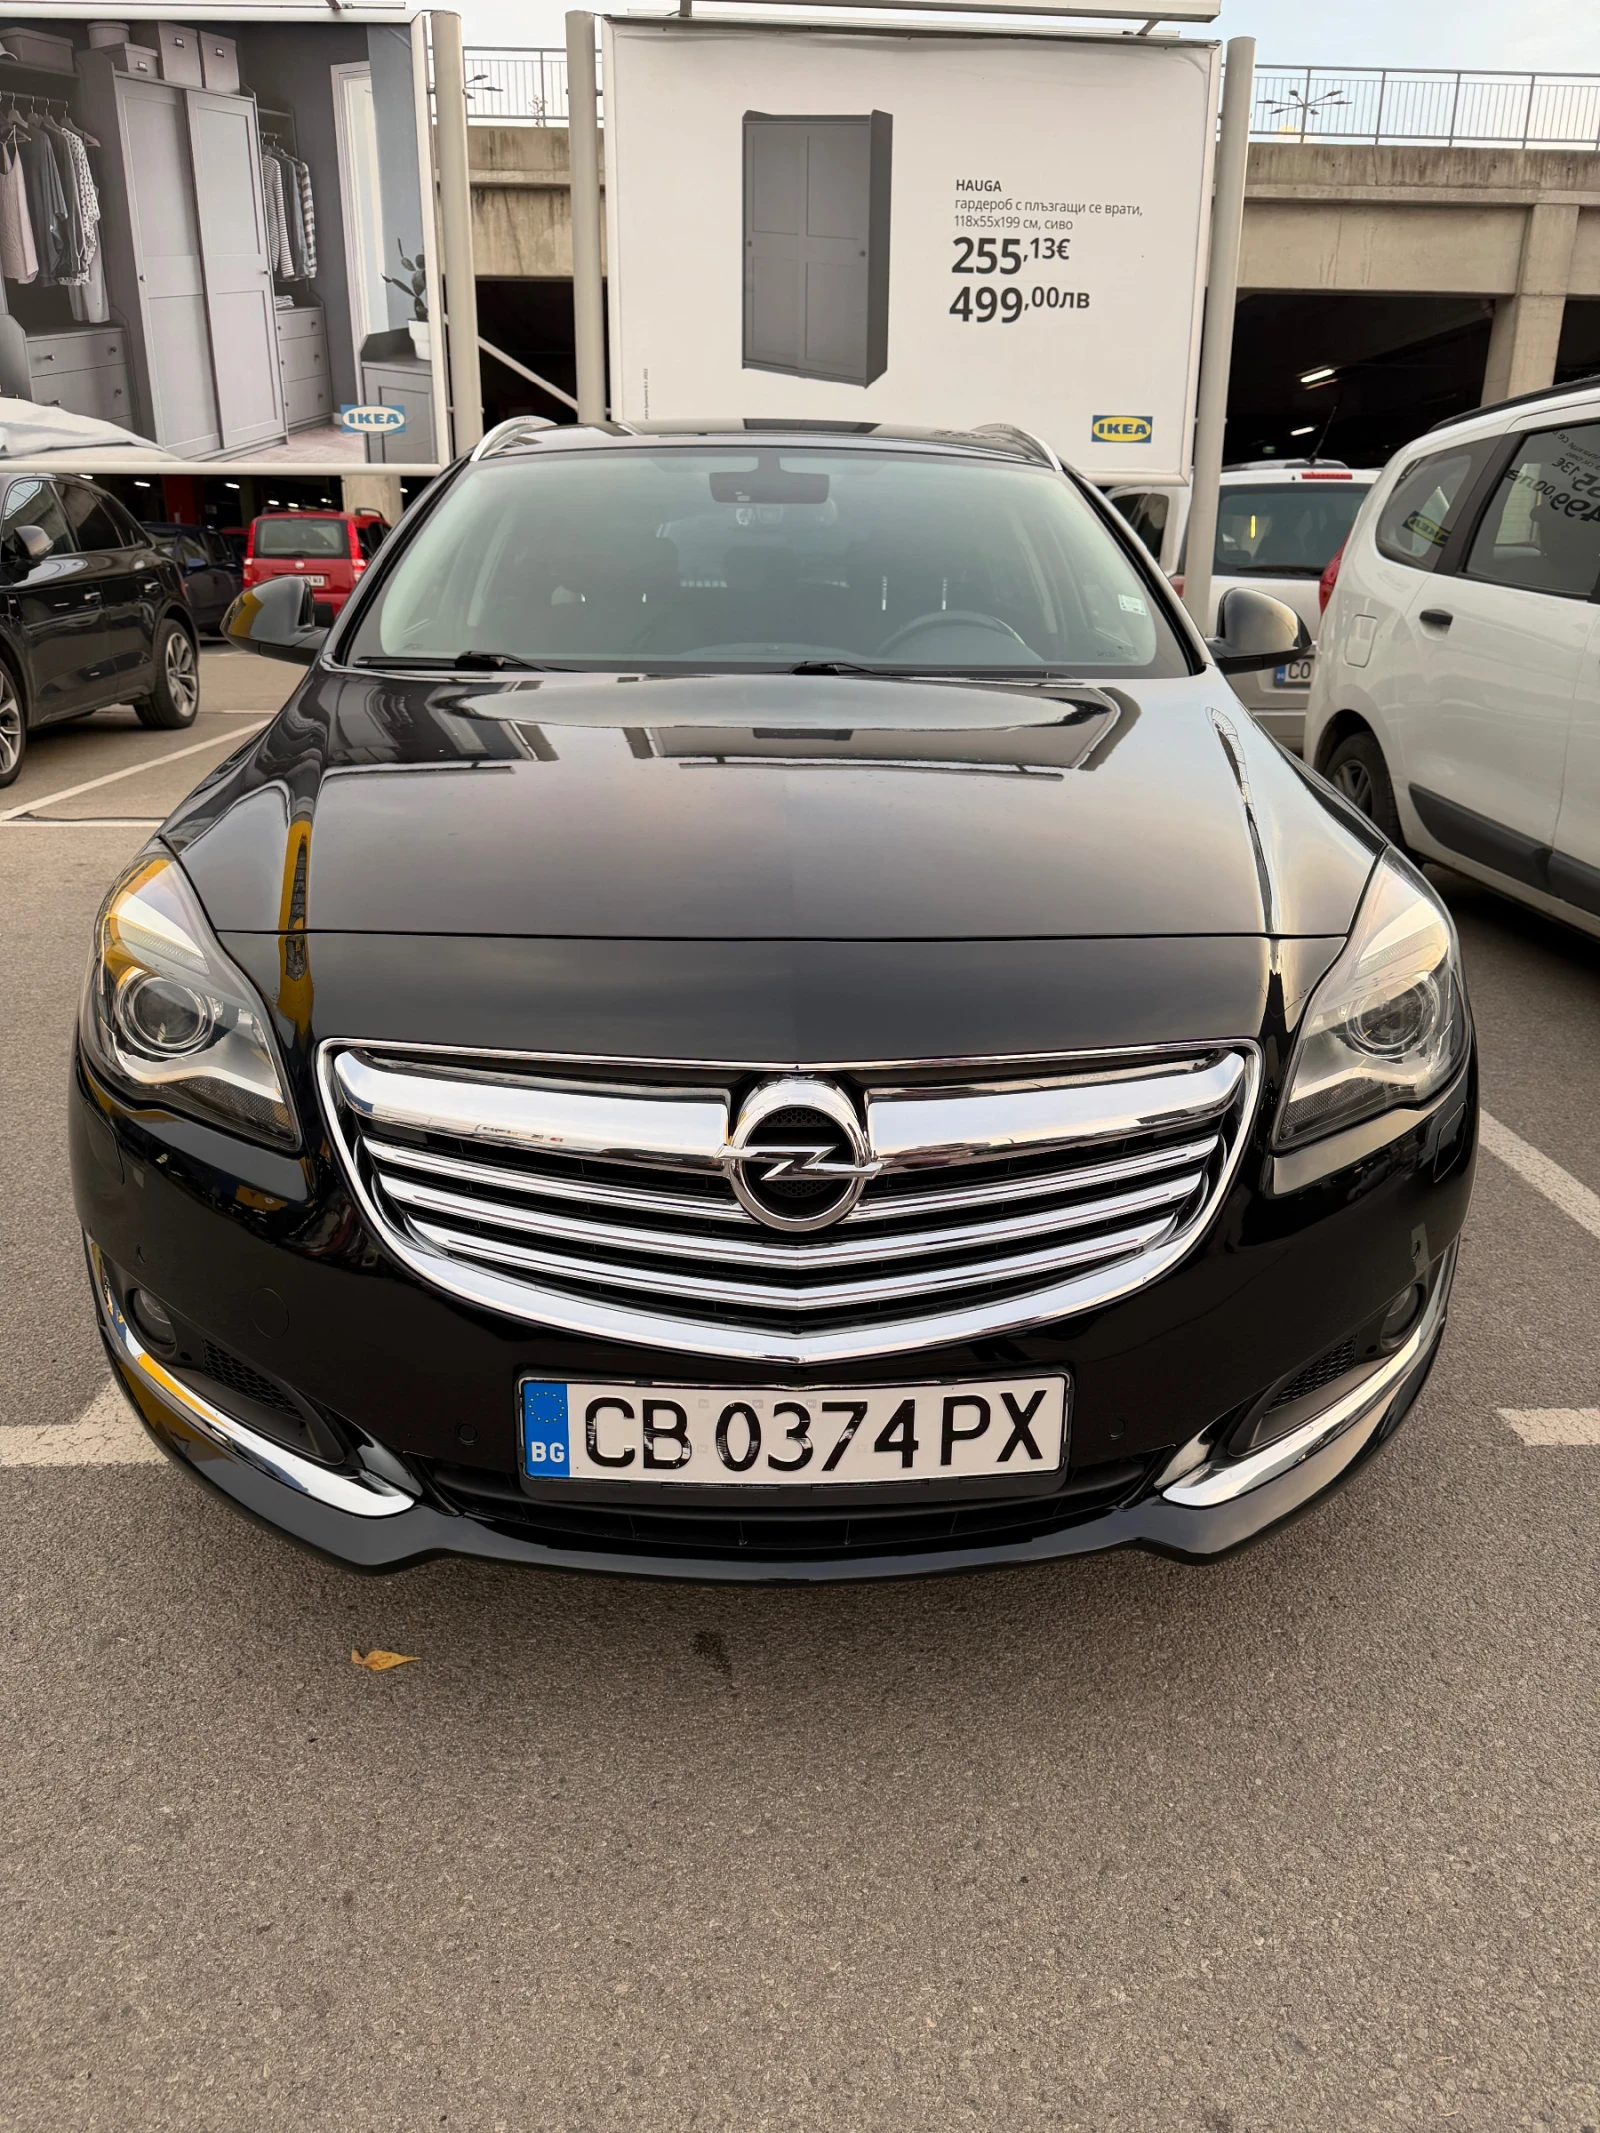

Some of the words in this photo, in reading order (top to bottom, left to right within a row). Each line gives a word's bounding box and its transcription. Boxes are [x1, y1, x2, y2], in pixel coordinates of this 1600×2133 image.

[956, 179, 1002, 192] HAUGA
[955, 198, 1013, 213] гардероб
[1016, 201, 1022, 211] с
[1025, 201, 1086, 215] плъзгащи
[1089, 203, 1102, 213] се
[1105, 204, 1143, 217] врати,
[1045, 220, 1073, 230] сиво
[348, 413, 401, 424] IKEA
[1098, 423, 1148, 435] IKEA
[585, 1397, 692, 1470] CB
[715, 1399, 919, 1472] 0374
[940, 1390, 1048, 1466] PX
[531, 1443, 565, 1463] BG
